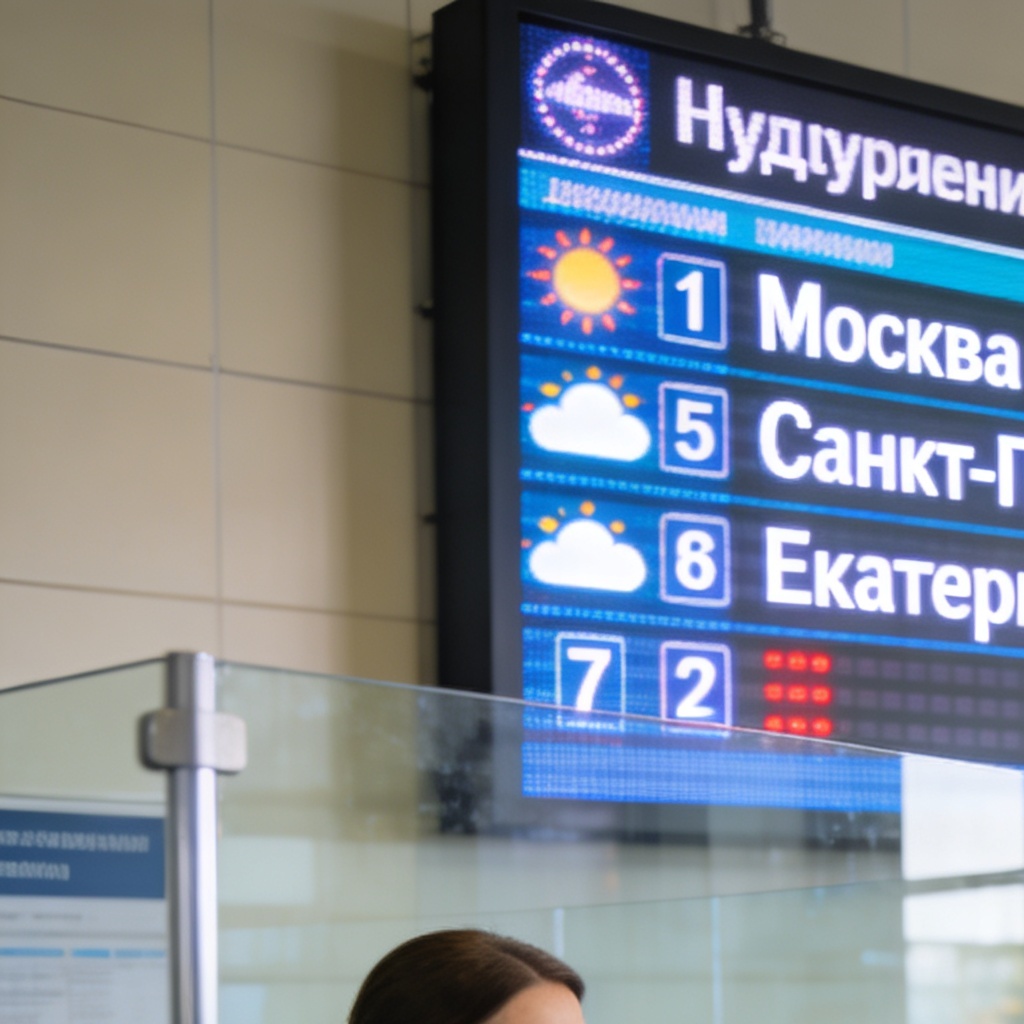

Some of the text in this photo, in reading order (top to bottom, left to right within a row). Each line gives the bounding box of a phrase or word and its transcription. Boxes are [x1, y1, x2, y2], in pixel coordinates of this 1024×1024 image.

[675, 270, 705, 332] 1
[758, 273, 1021, 390] Москва
[674, 398, 715, 461] 5
[674, 529, 717, 591] 8
[566, 646, 612, 712] 7
[674, 655, 717, 718] 2
